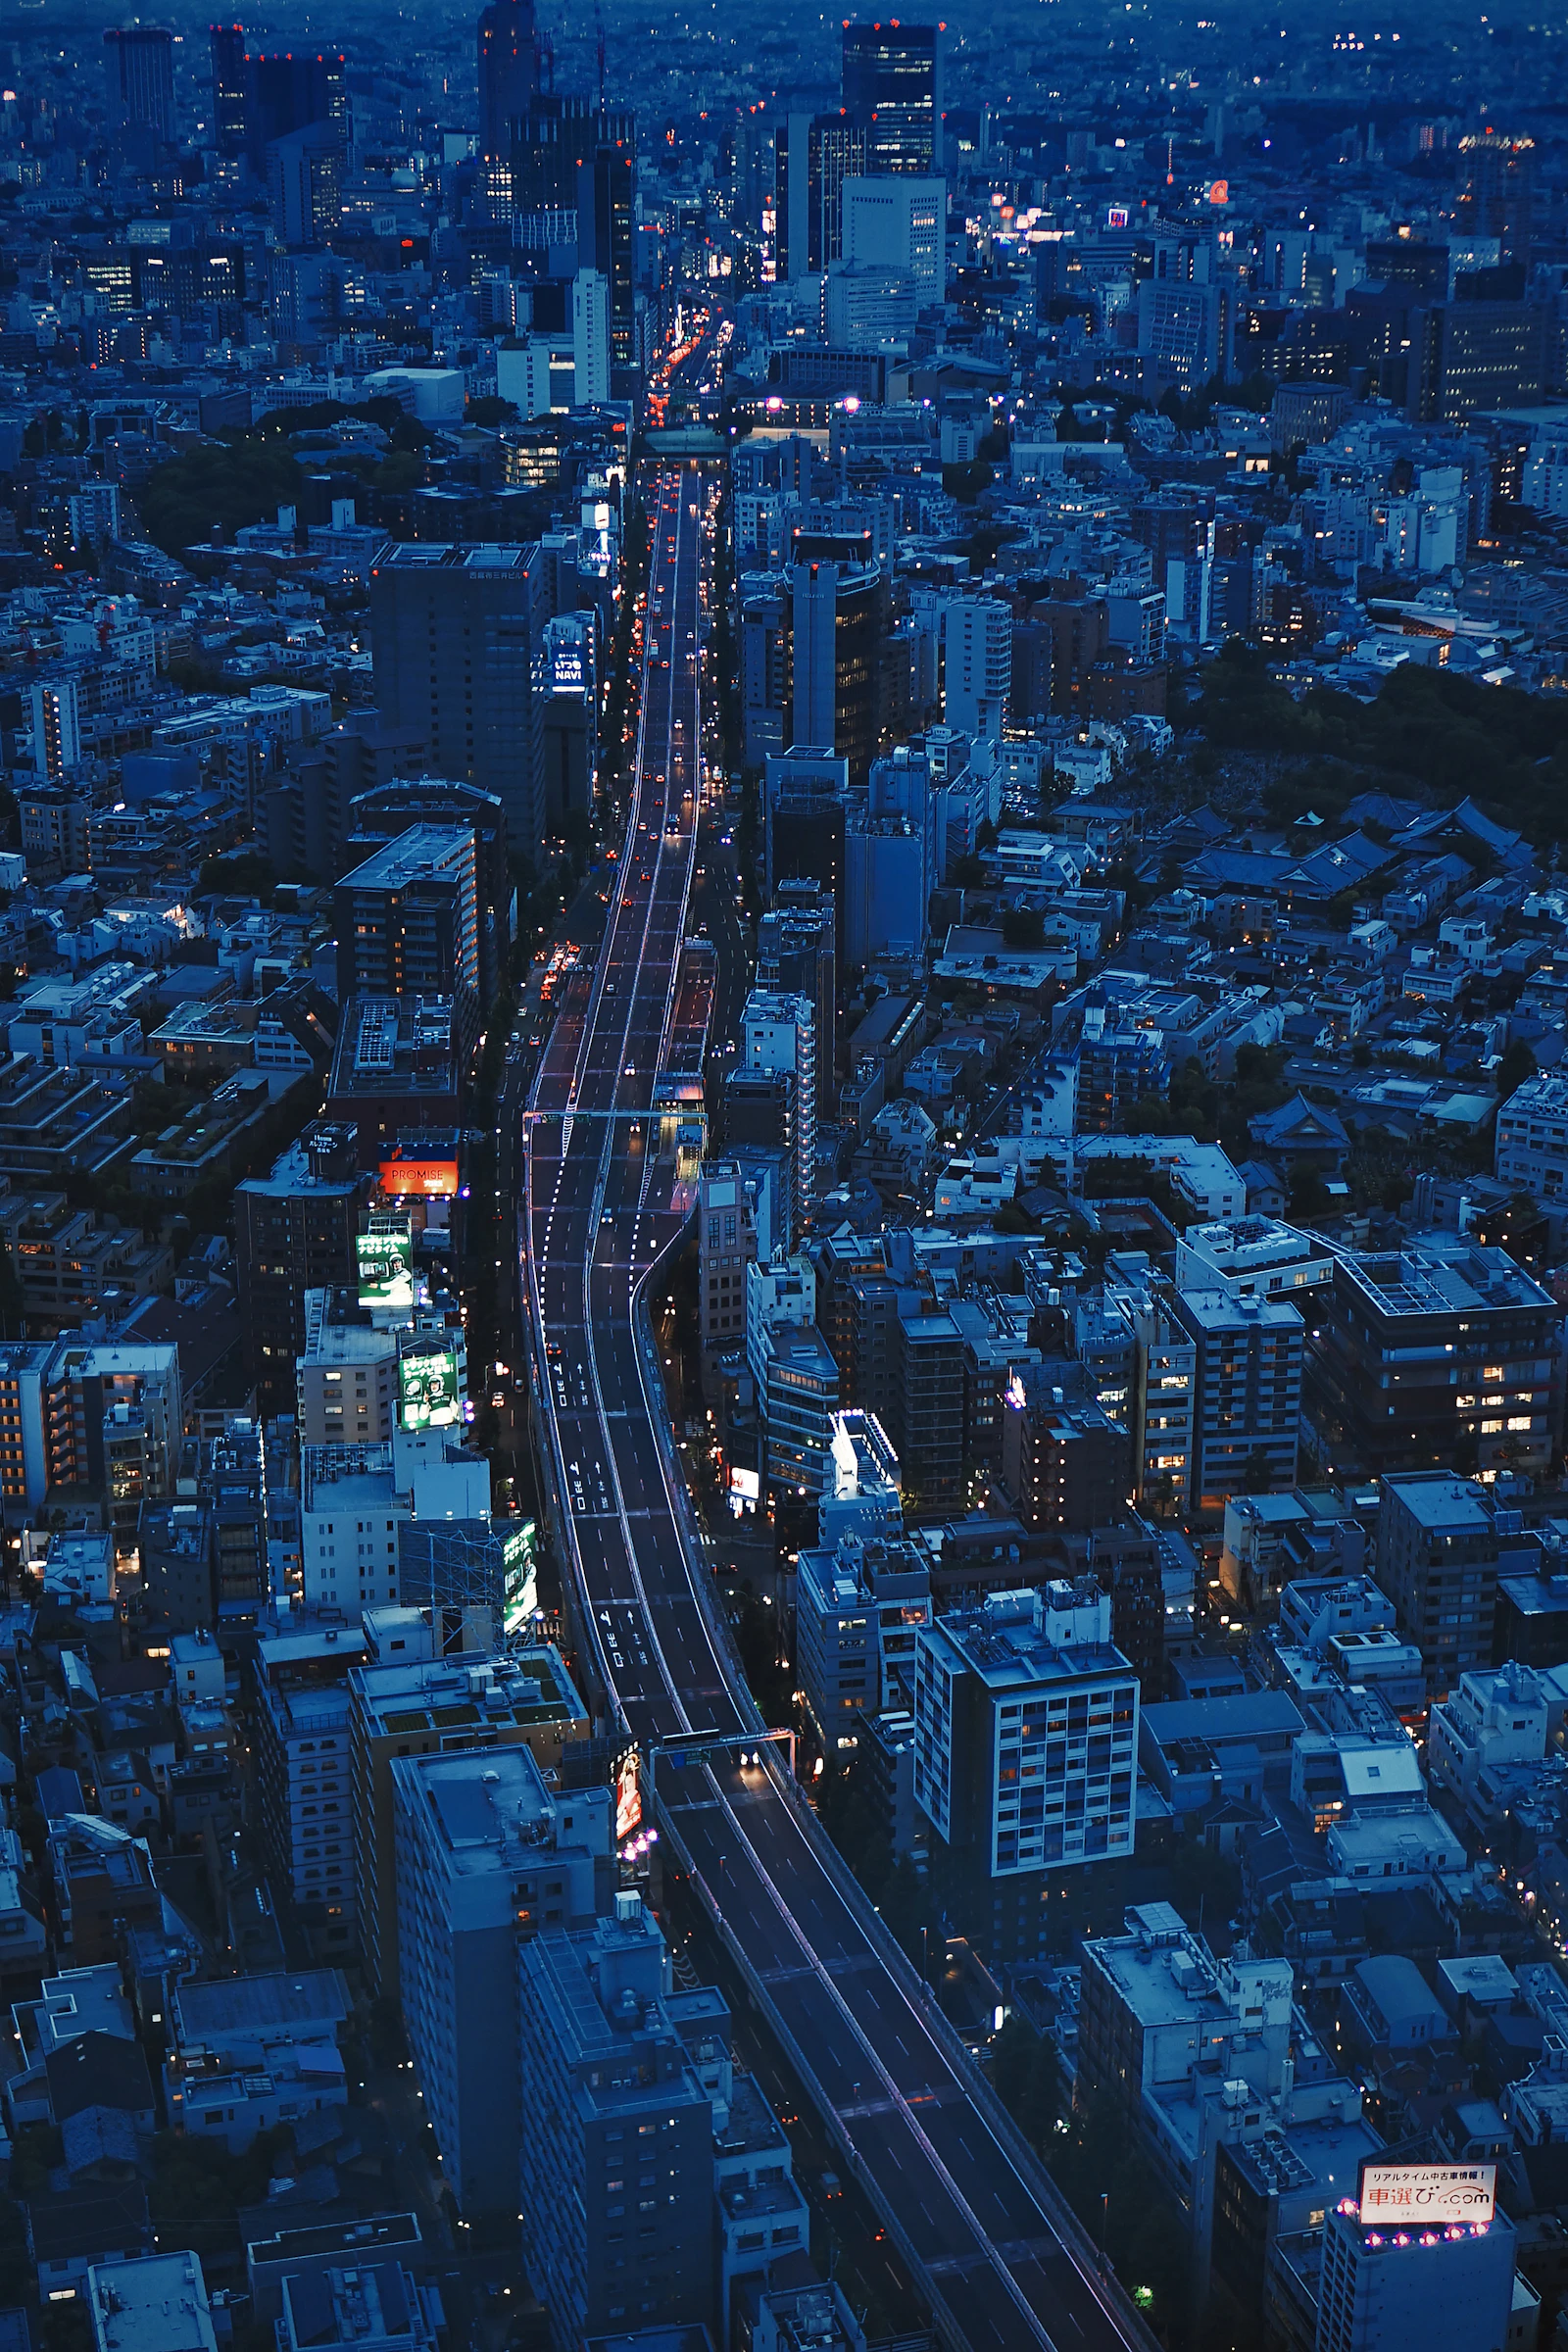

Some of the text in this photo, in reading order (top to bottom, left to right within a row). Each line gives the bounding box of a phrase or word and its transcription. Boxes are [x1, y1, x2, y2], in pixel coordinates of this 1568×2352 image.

[555, 661, 581, 670] いつも
[556, 670, 581, 680] NAVI
[392, 1169, 443, 1180] PROMISE
[358, 1245, 399, 1254] ナビタイム
[607, 1632, 624, 1668] 出口
[1373, 2171, 1485, 2181] リアルタイム中古車情報!
[1367, 2184, 1490, 2207] 車選び.com
